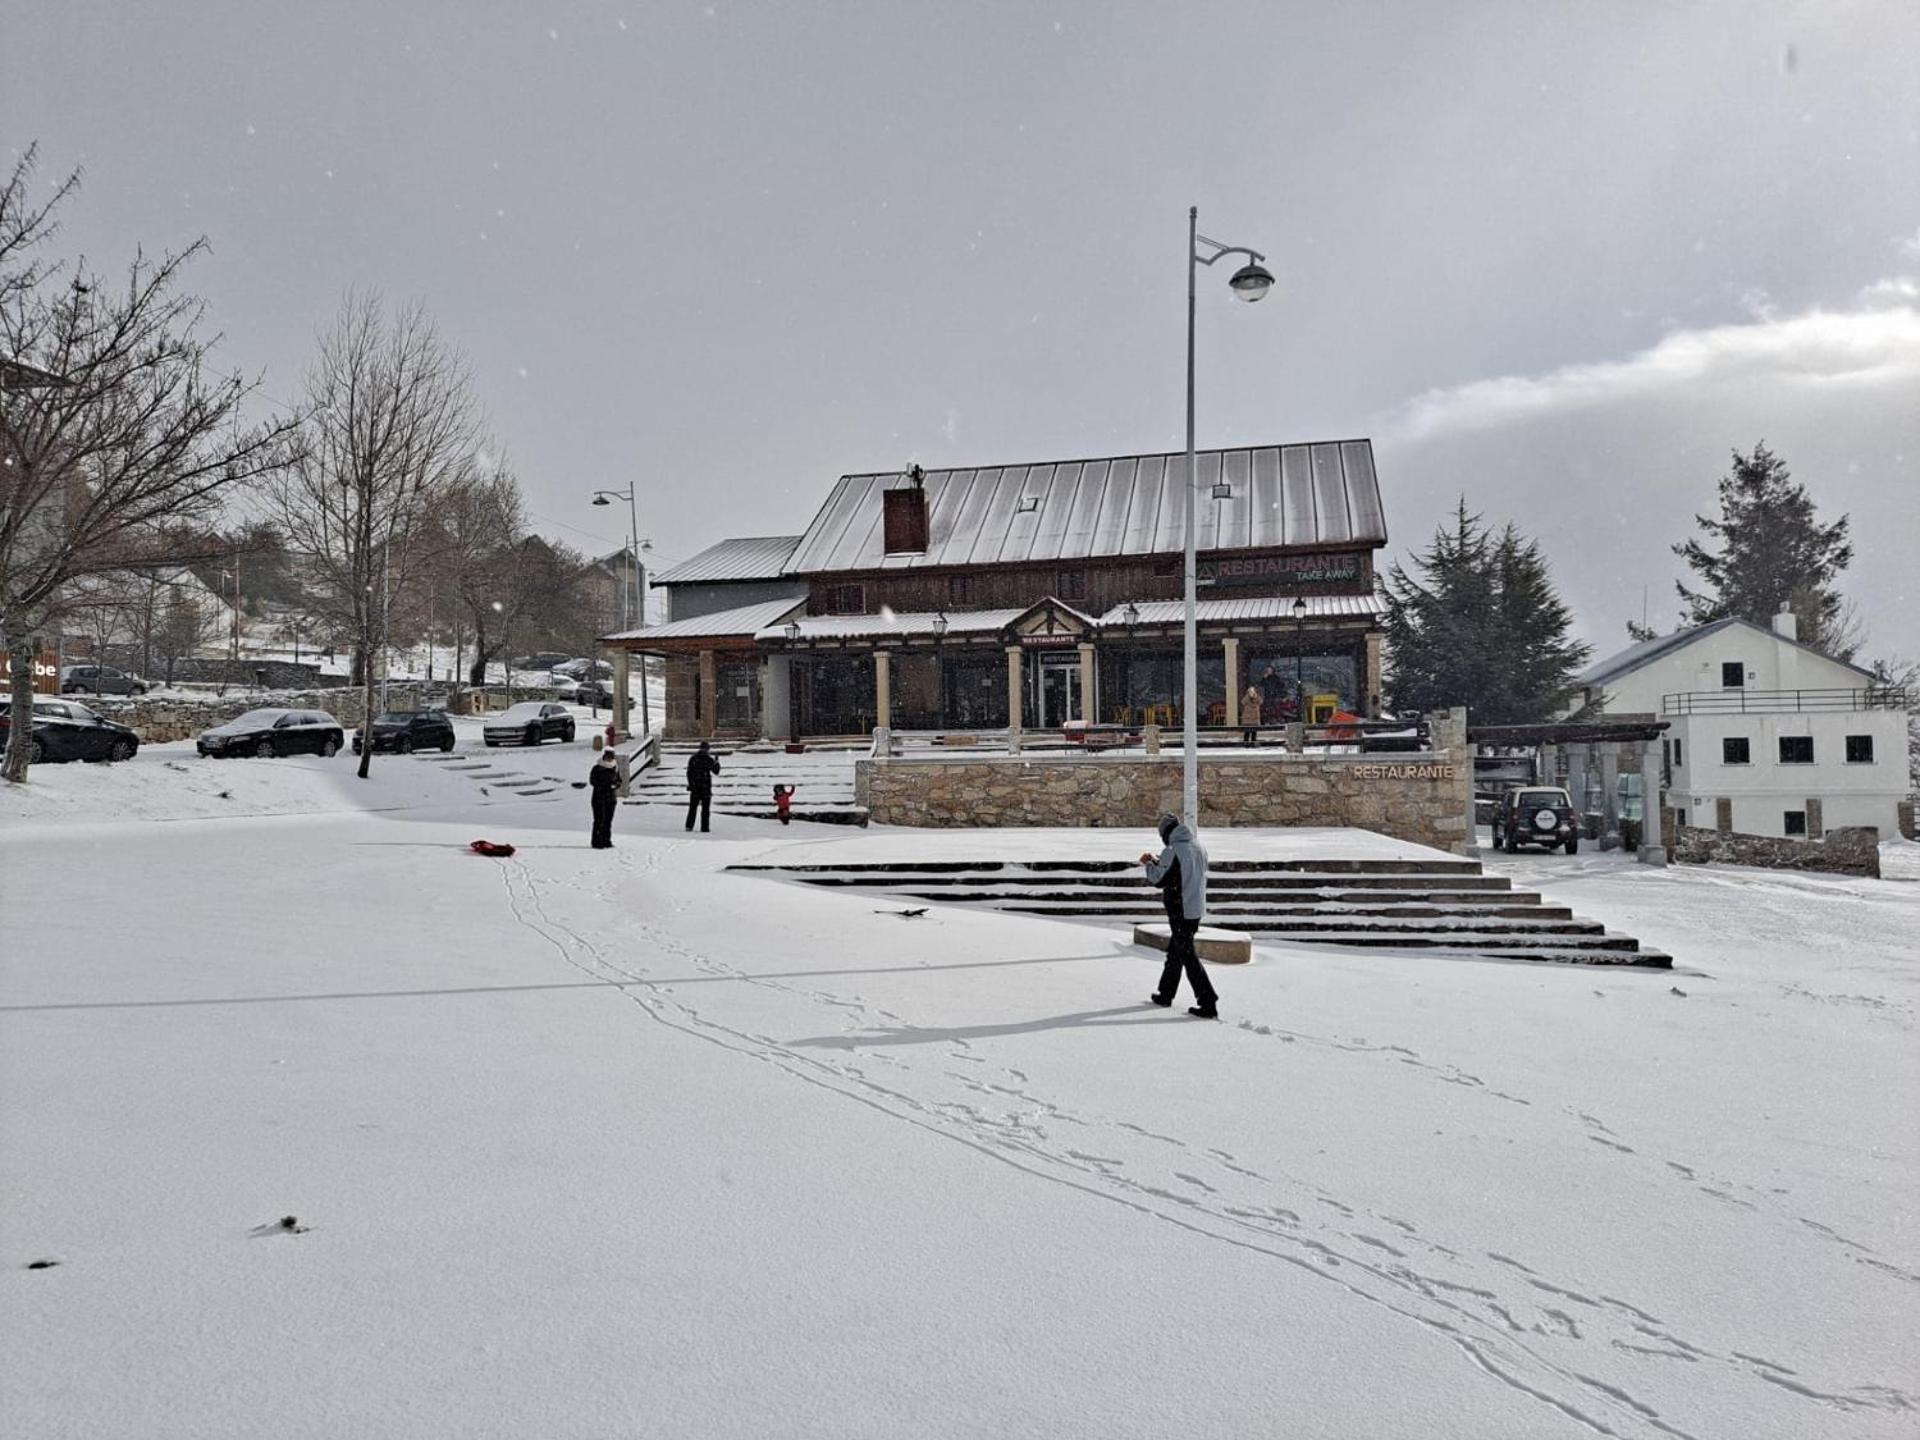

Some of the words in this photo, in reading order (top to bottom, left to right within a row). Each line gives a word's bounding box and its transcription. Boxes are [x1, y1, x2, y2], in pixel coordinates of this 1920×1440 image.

[1218, 554, 1355, 576] RESTAURANTE
[1296, 571, 1323, 581] TAKE
[1326, 568, 1355, 579] AWAY
[1354, 766, 1453, 778] RESTAURANTE
